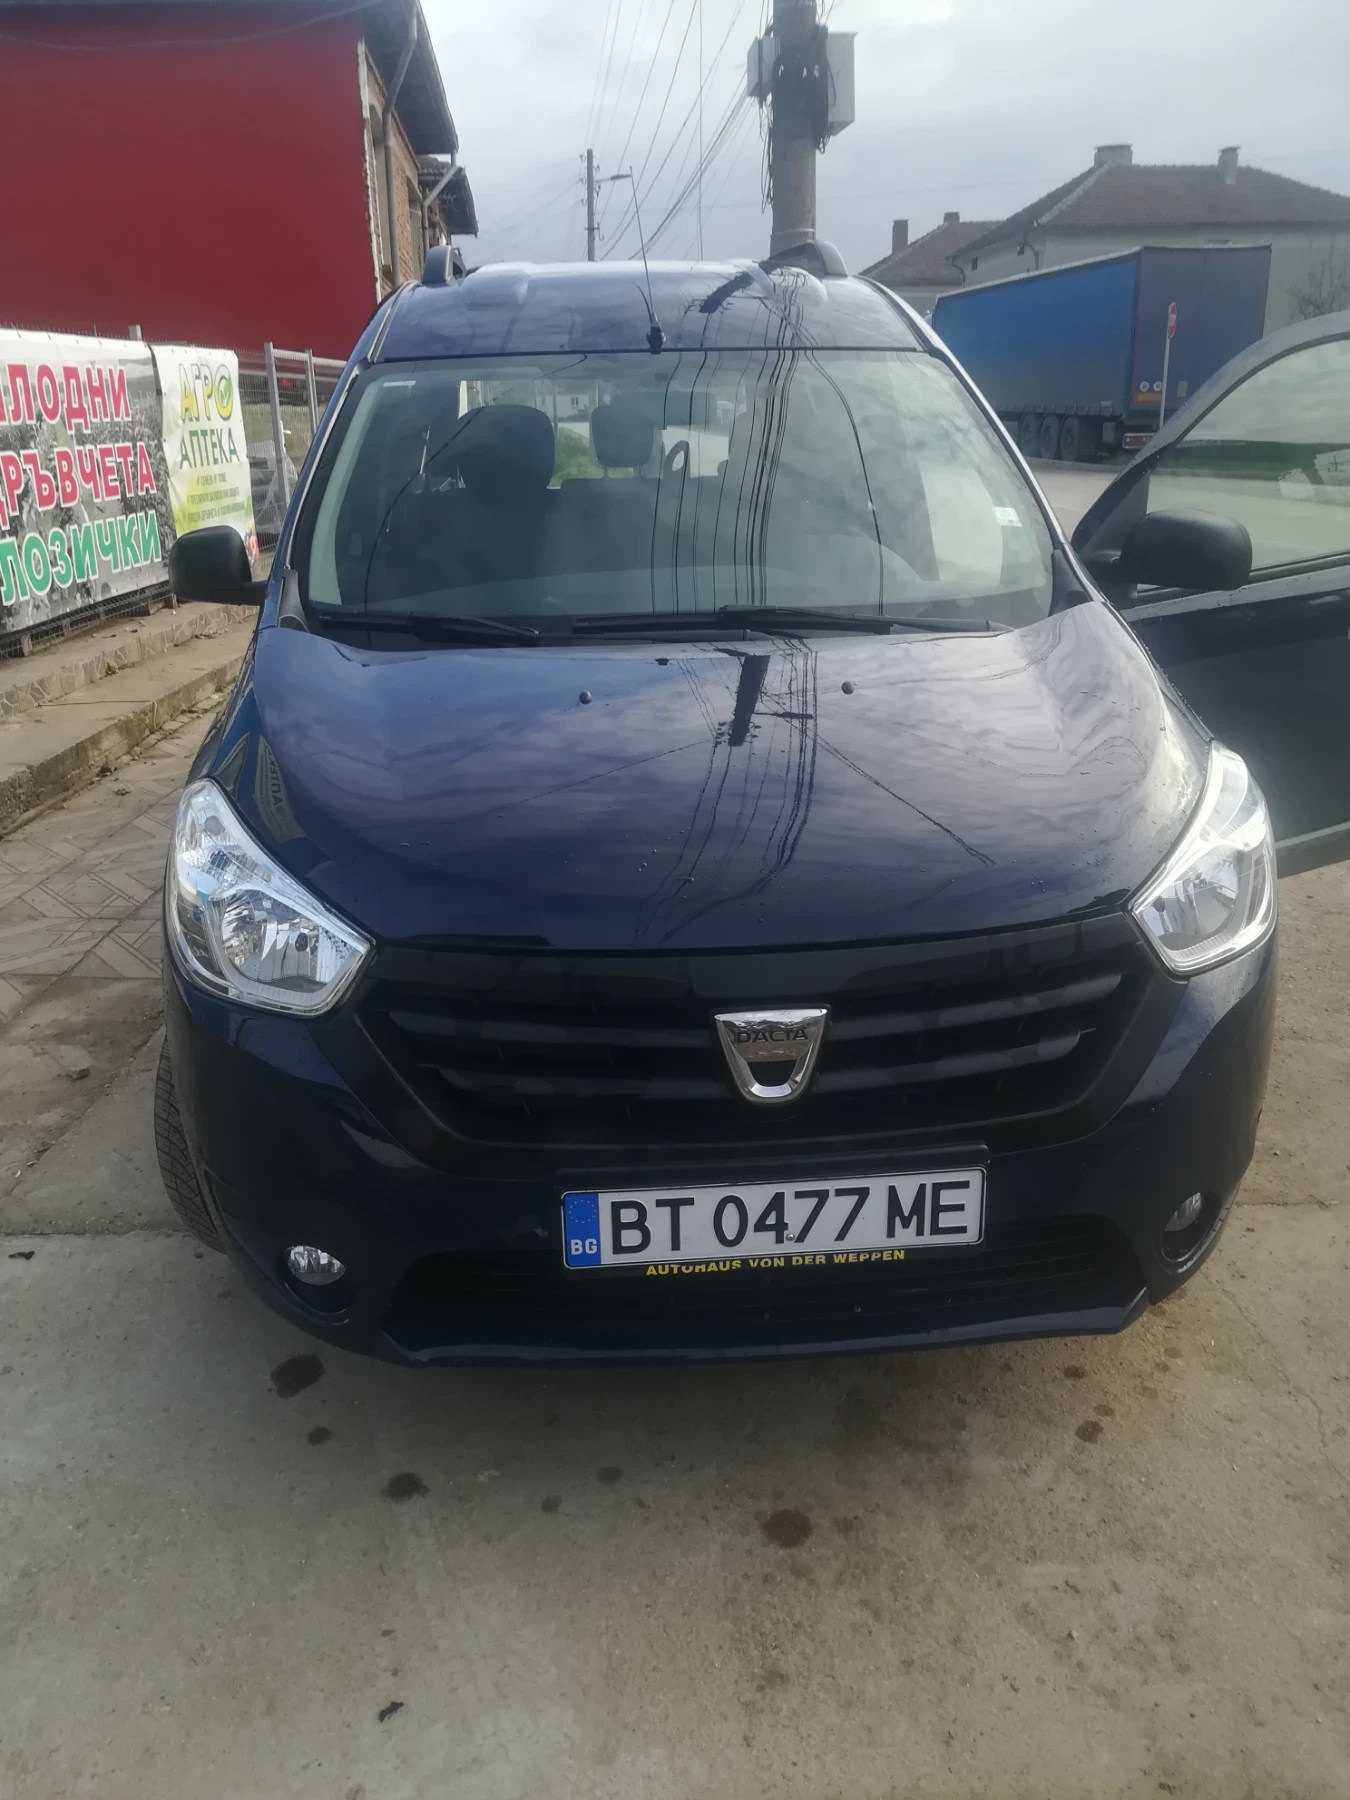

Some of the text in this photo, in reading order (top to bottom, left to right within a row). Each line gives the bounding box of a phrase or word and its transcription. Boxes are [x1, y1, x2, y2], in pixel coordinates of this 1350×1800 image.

[0, 363, 132, 433] ЛОДНИ
[179, 363, 234, 421] АГРО
[180, 427, 241, 470] АПТЕКА
[0, 442, 156, 530] РЪВЧЕТА
[0, 509, 162, 604] ЛОЗИЧКИ
[736, 1027, 809, 1043] DACIA
[611, 1180, 971, 1255] BT 0477 ME
[570, 1238, 598, 1256] BG
[646, 1249, 906, 1276] AUTOHAUS VON DER WEPPEN
